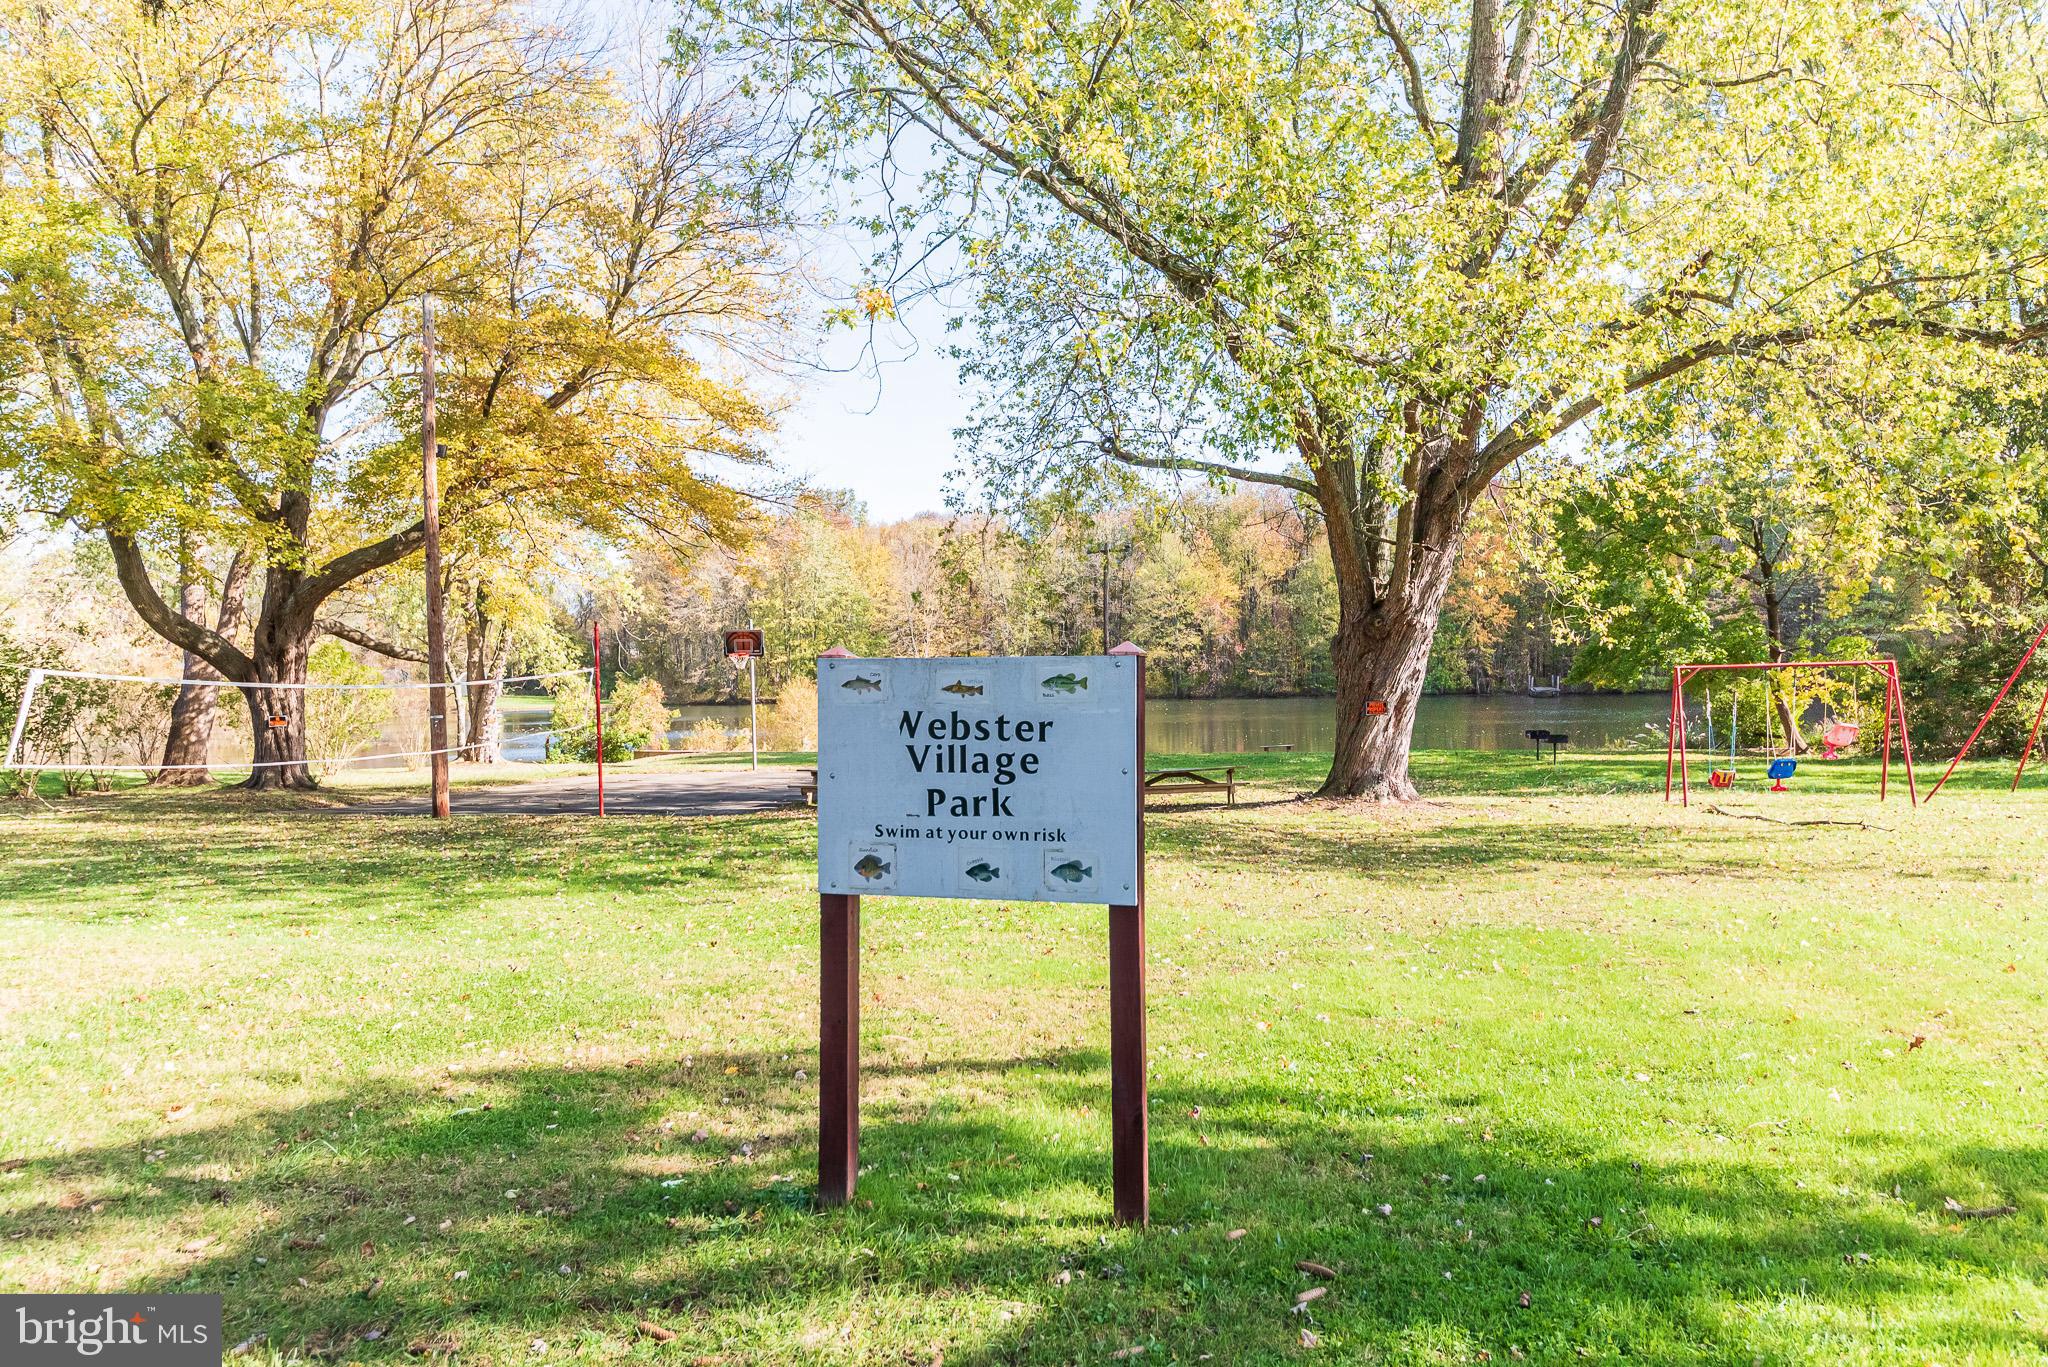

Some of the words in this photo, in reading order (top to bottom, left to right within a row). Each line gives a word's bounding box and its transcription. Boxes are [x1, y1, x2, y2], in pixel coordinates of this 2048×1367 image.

[899, 710, 1054, 743] Webster
[905, 744, 1040, 785] Village
[927, 788, 1015, 817] Park
[874, 824, 920, 839] Swim
[925, 826, 943, 839] at
[947, 829, 988, 843] your
[992, 829, 1030, 842] own
[1034, 828, 1066, 842] risk
